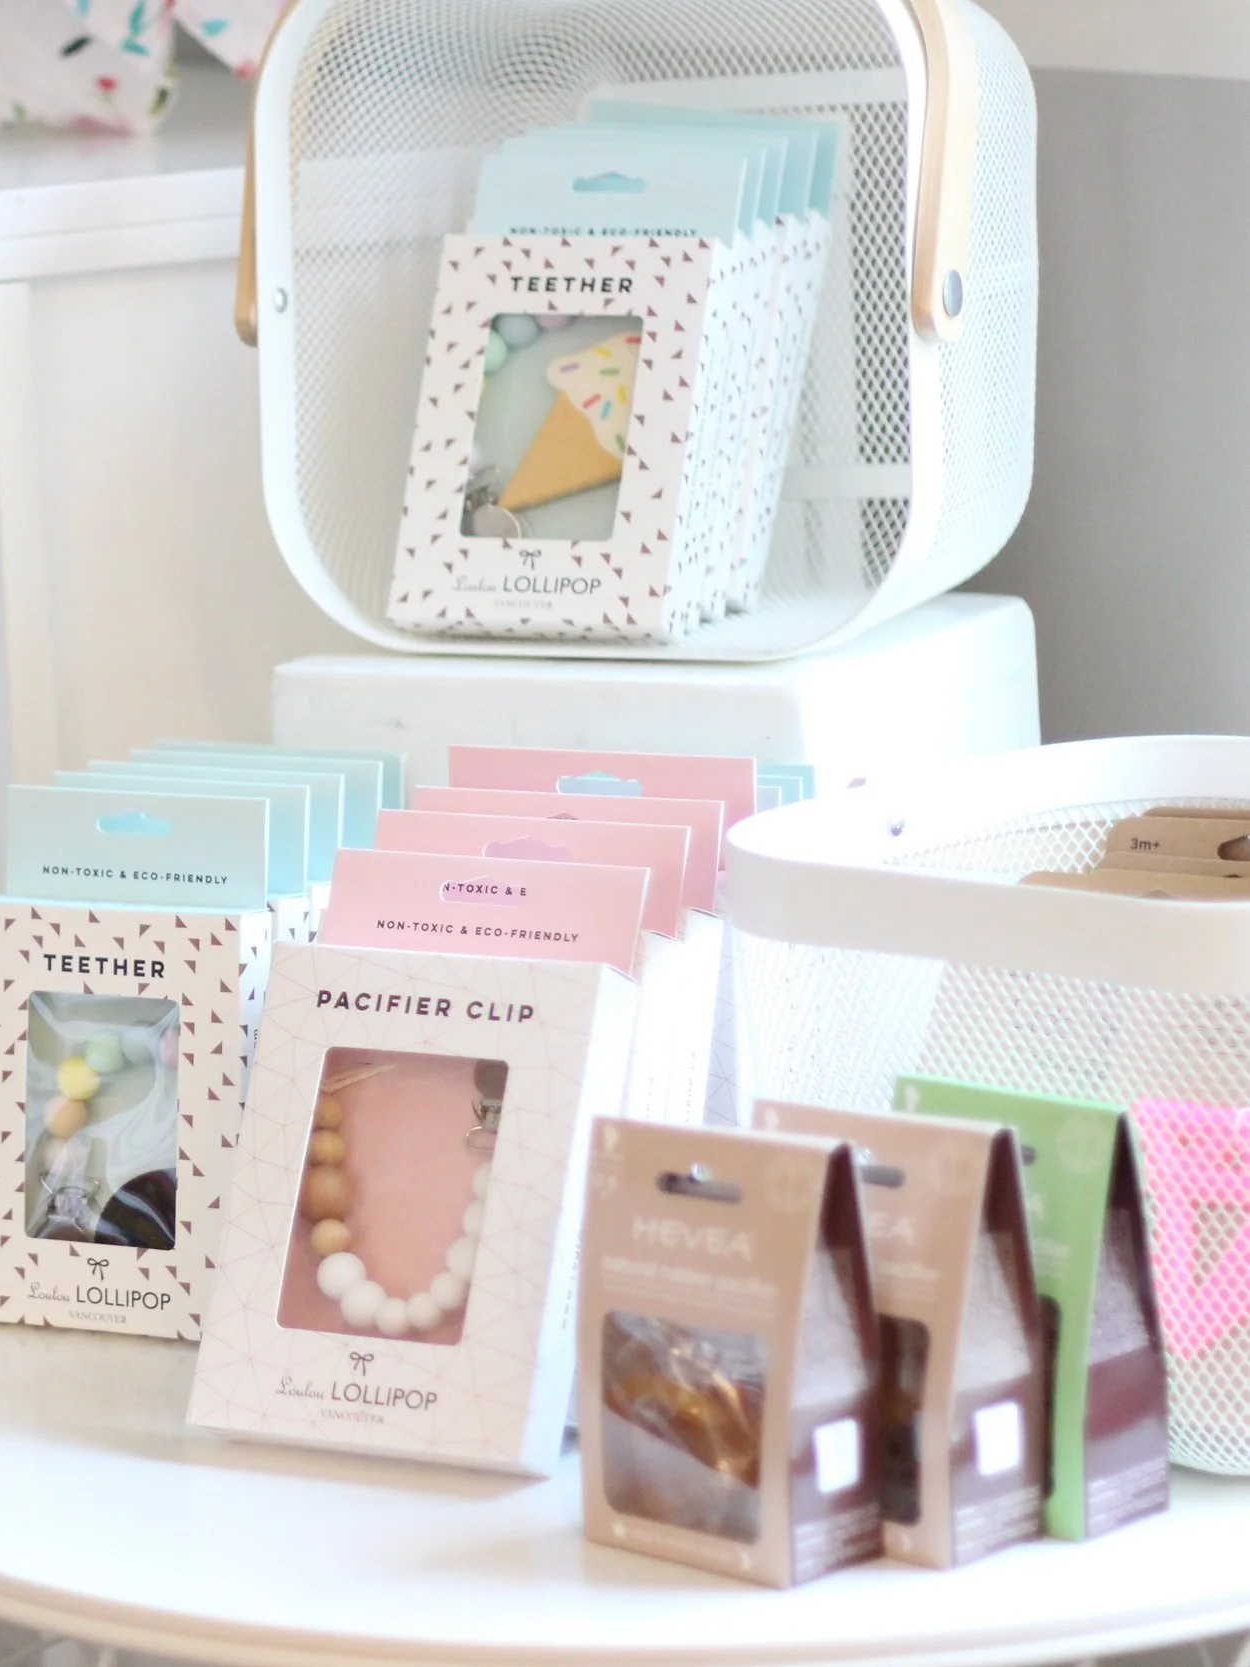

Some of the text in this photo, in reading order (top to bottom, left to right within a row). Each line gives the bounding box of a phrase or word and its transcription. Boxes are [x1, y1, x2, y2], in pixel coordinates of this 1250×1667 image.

[510, 227, 697, 237] NON-TOXIC & ECO-FRIENDLY
[510, 276, 633, 293] TEETHER
[503, 575, 601, 595] LOLLIPOP
[1130, 838, 1160, 850] 3m+
[42, 866, 229, 885] NON-TOXIC & ECO-FRIENDLY
[442, 883, 499, 895] N-TOXIC
[505, 886, 513, 896] &
[377, 920, 579, 942] NON-TOXIC & ECO-FRIENDLY
[43, 953, 165, 979] TEETHER
[316, 990, 534, 1023] PACIFIER CLIP
[632, 1215, 752, 1262] HEVEA
[27, 1282, 171, 1310] Loulou LOLLIPOP
[69, 1310, 127, 1324] VANCOUVER
[276, 1376, 438, 1411] Loulou LOLLIPOP
